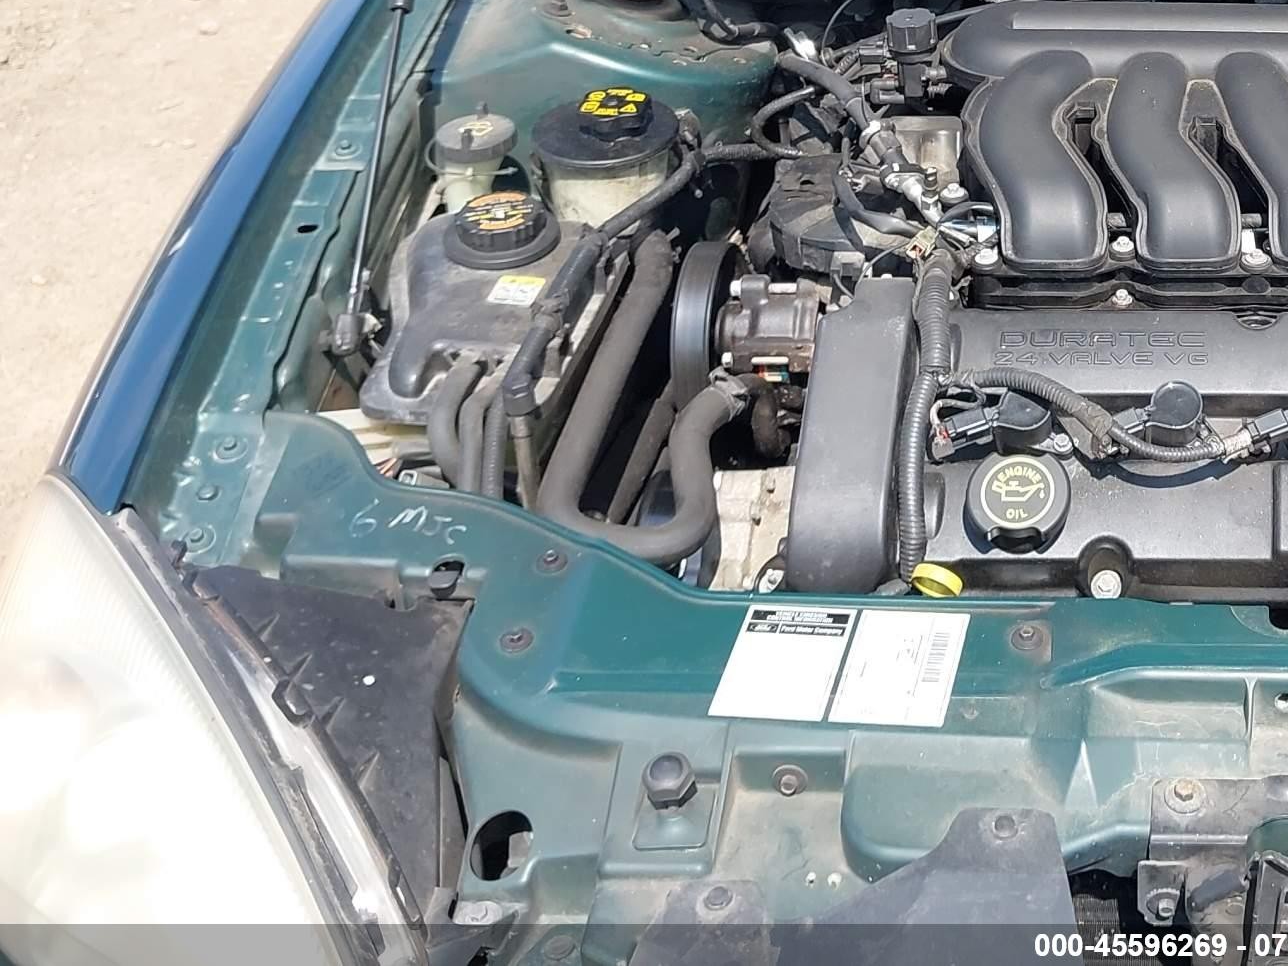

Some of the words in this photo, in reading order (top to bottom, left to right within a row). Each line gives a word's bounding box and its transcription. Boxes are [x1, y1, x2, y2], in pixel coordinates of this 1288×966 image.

[1000, 331, 1206, 348] DURATEC
[994, 352, 1038, 366] 24
[1049, 351, 1154, 366] VALVE
[997, 465, 1042, 484] ENGINE
[1005, 508, 1028, 520] OIL
